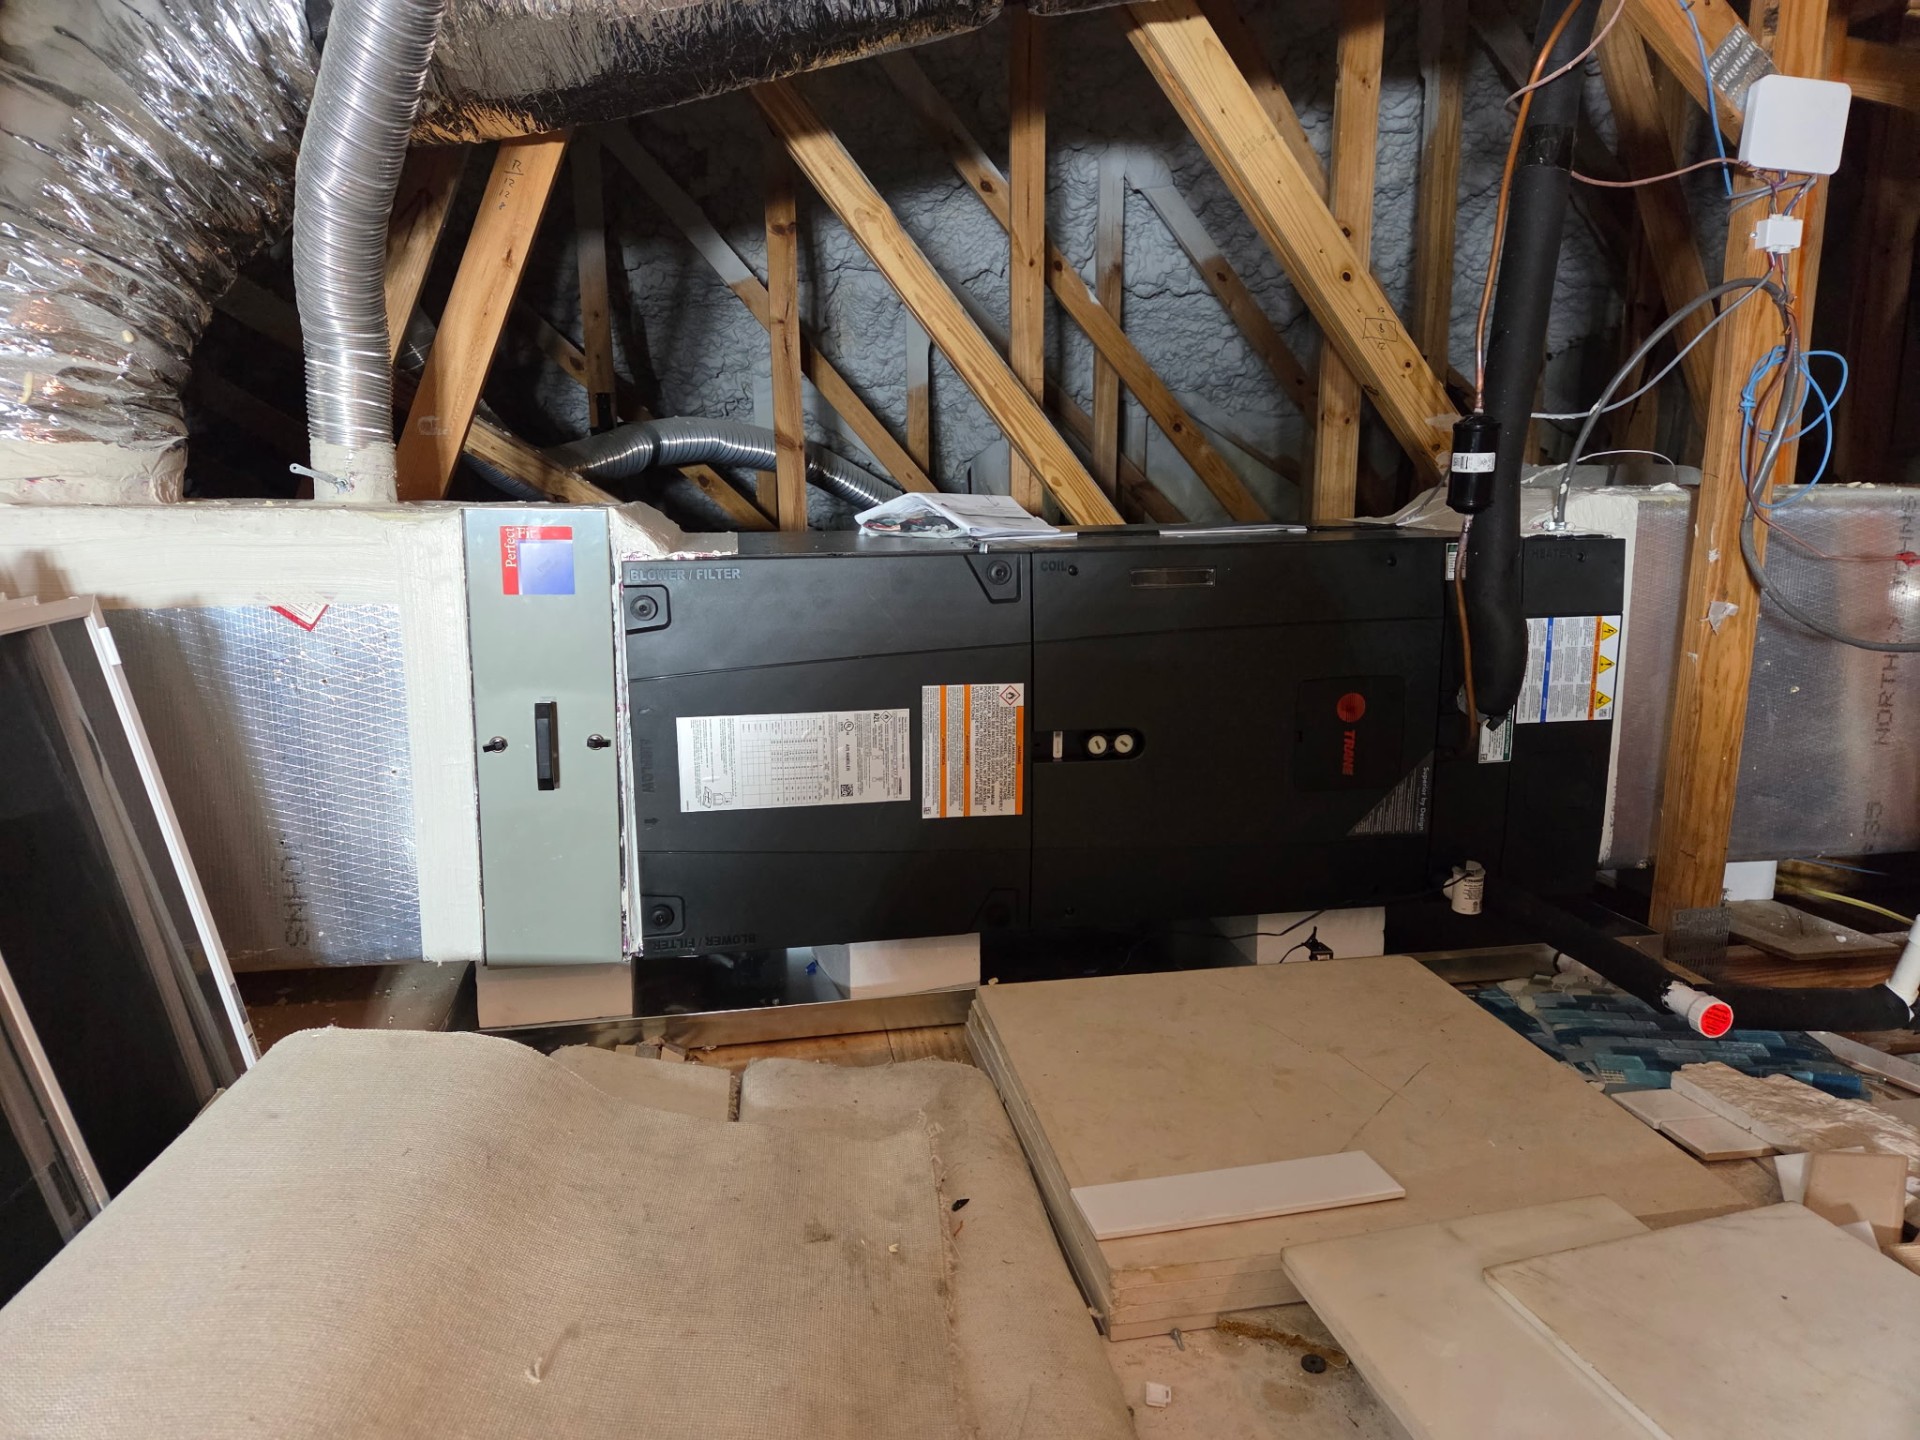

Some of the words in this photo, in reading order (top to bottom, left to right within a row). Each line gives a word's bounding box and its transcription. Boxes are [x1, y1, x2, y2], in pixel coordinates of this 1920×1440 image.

[512, 159, 522, 172] R
[504, 527, 517, 568] Perfect
[630, 569, 686, 582] BLOWER
[696, 567, 741, 580] FILTER
[1040, 560, 1067, 572] COIL
[1875, 654, 1900, 746] NORTH
[1343, 730, 1355, 776] TRANE
[640, 739, 655, 794] AIRFLOW
[1420, 767, 1430, 796] Superior
[1418, 808, 1426, 831] Design
[654, 938, 696, 951] FILTER
[705, 933, 756, 946] BLOWER
